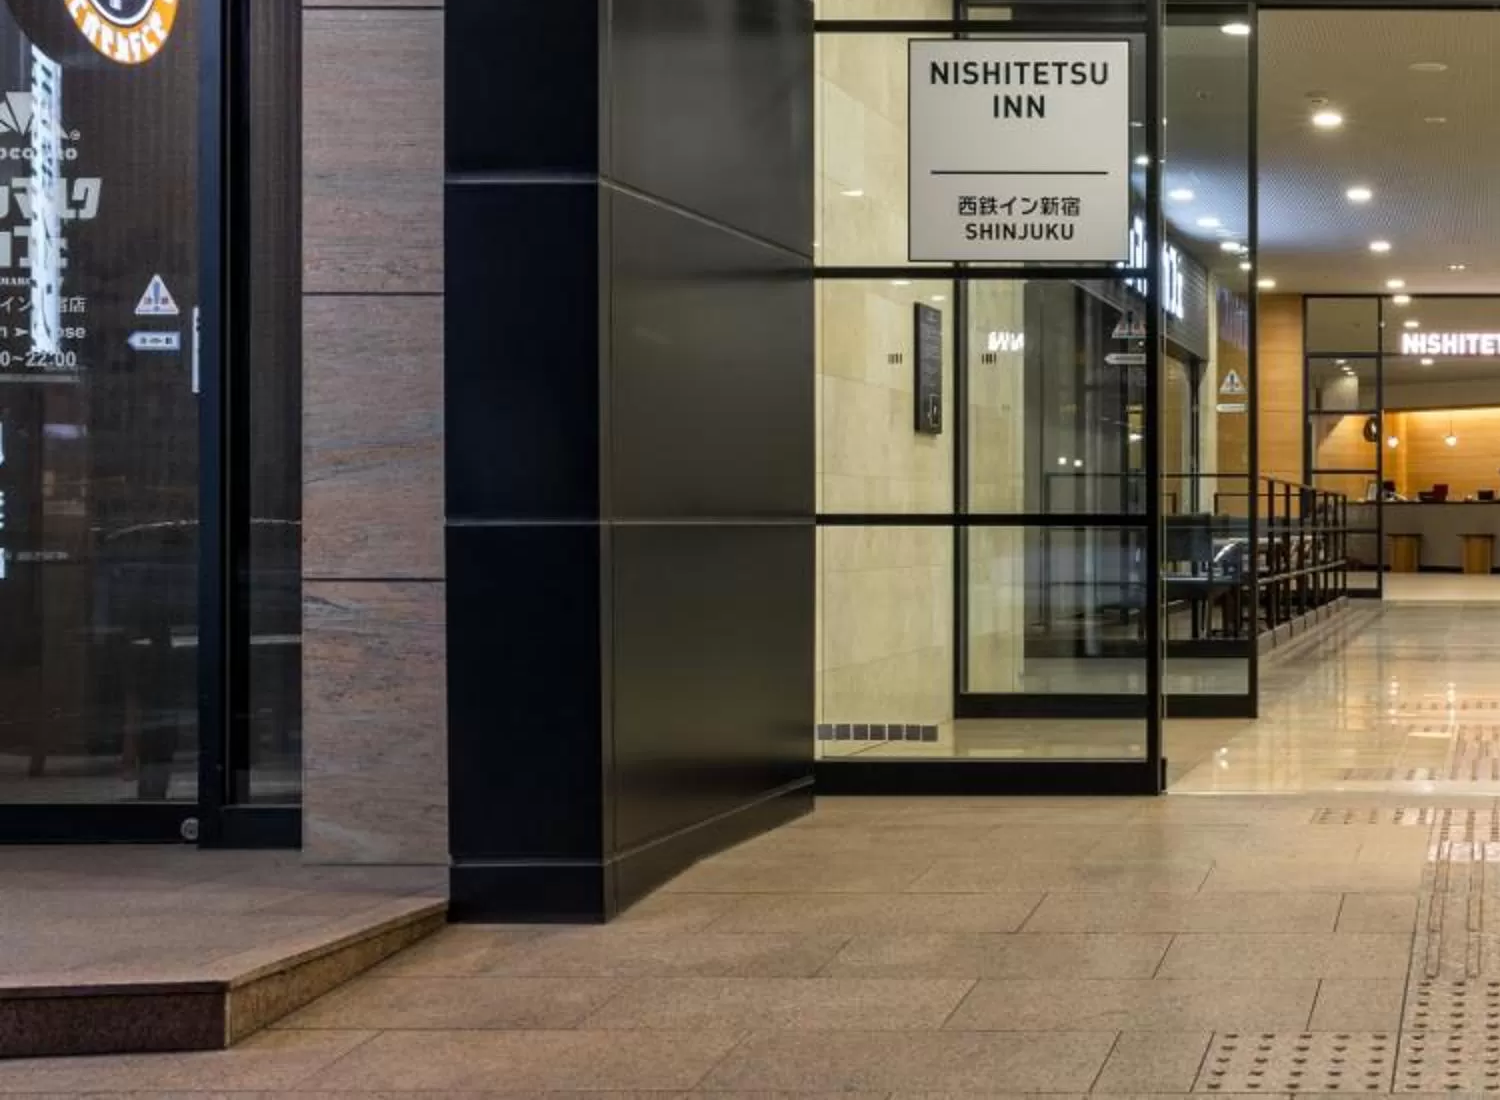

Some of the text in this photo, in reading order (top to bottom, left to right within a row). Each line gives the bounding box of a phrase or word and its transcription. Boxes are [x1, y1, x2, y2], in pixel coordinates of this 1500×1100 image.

[930, 61, 1110, 86] NISHITETSU
[992, 95, 1046, 118] INN
[957, 195, 1081, 217] 西鉄イン新宿
[965, 223, 1075, 242] SHINJUKU
